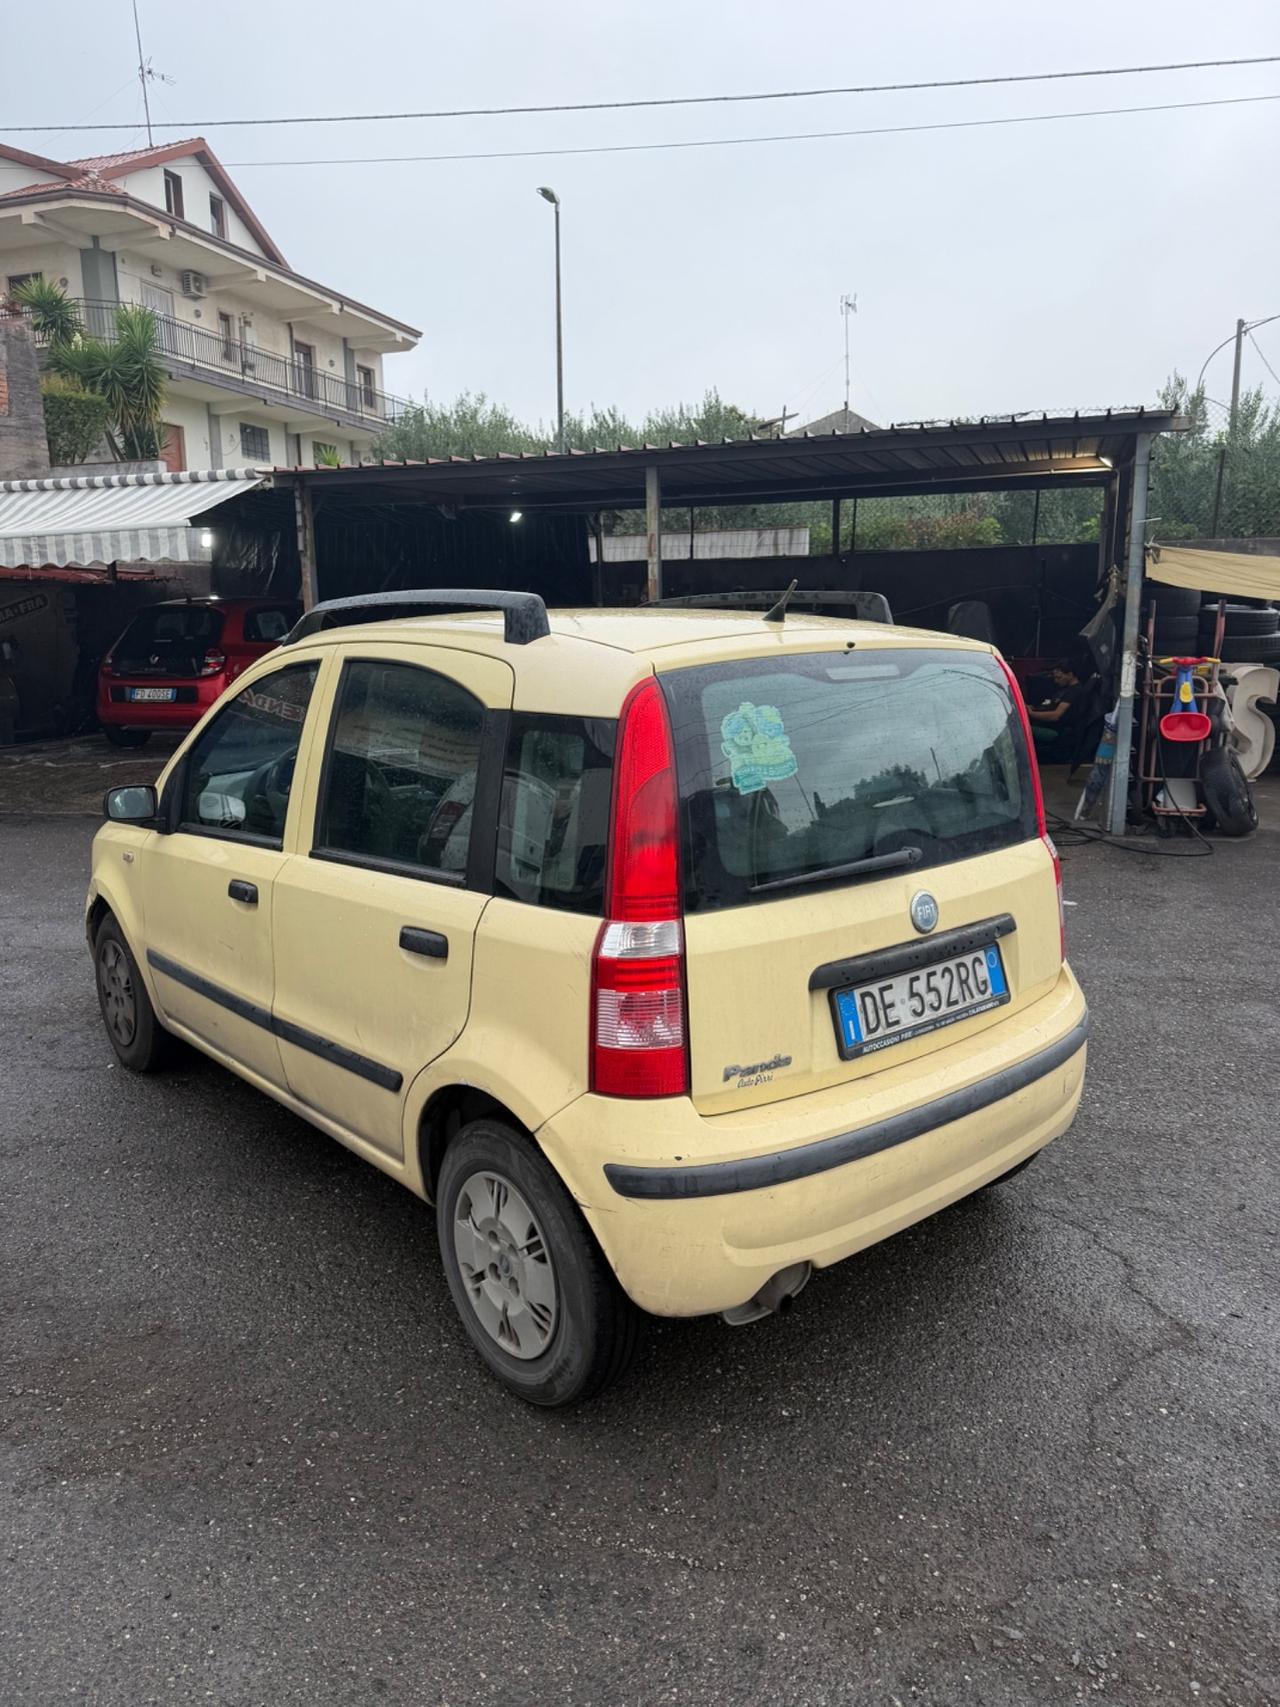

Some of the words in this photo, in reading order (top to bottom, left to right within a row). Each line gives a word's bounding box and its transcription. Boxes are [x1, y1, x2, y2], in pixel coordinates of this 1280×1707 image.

[917, 903, 936, 920] FIAT
[861, 983, 900, 1036] DE
[908, 956, 989, 1018] 552RG
[722, 1053, 793, 1083] Panda
